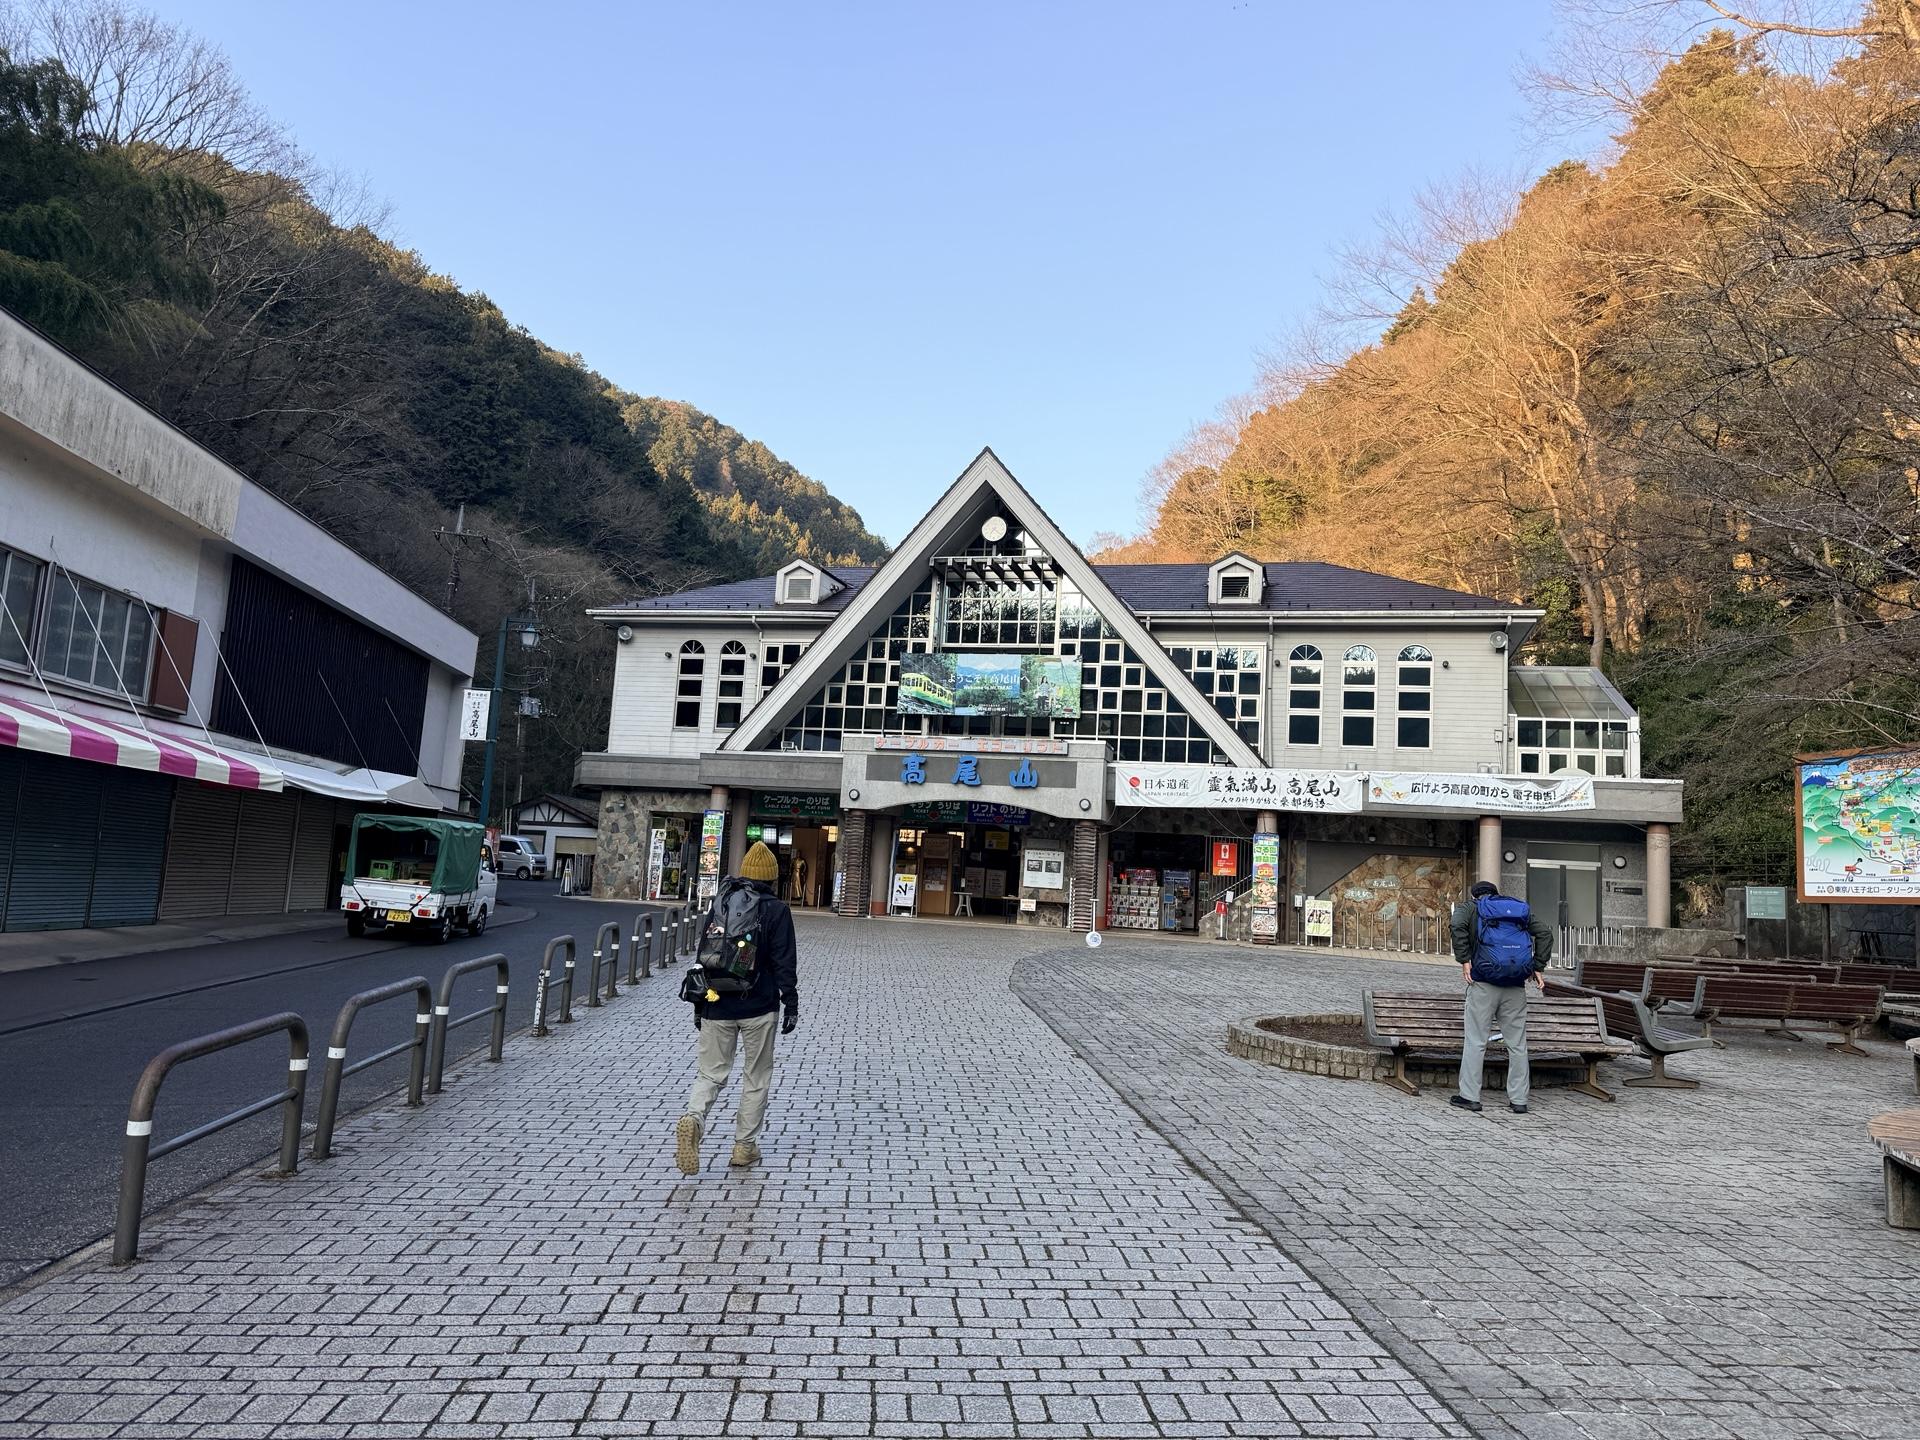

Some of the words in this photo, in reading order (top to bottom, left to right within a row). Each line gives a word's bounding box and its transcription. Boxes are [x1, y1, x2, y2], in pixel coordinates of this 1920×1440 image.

[468, 709, 480, 738] 高尾山
[875, 737, 960, 750] ケーブルカー
[1144, 779, 1190, 790] 日本遺産
[1287, 777, 1341, 797] 高尾山
[1411, 782, 1510, 799] 広げよう高尾の町から
[972, 803, 998, 812] リフト
